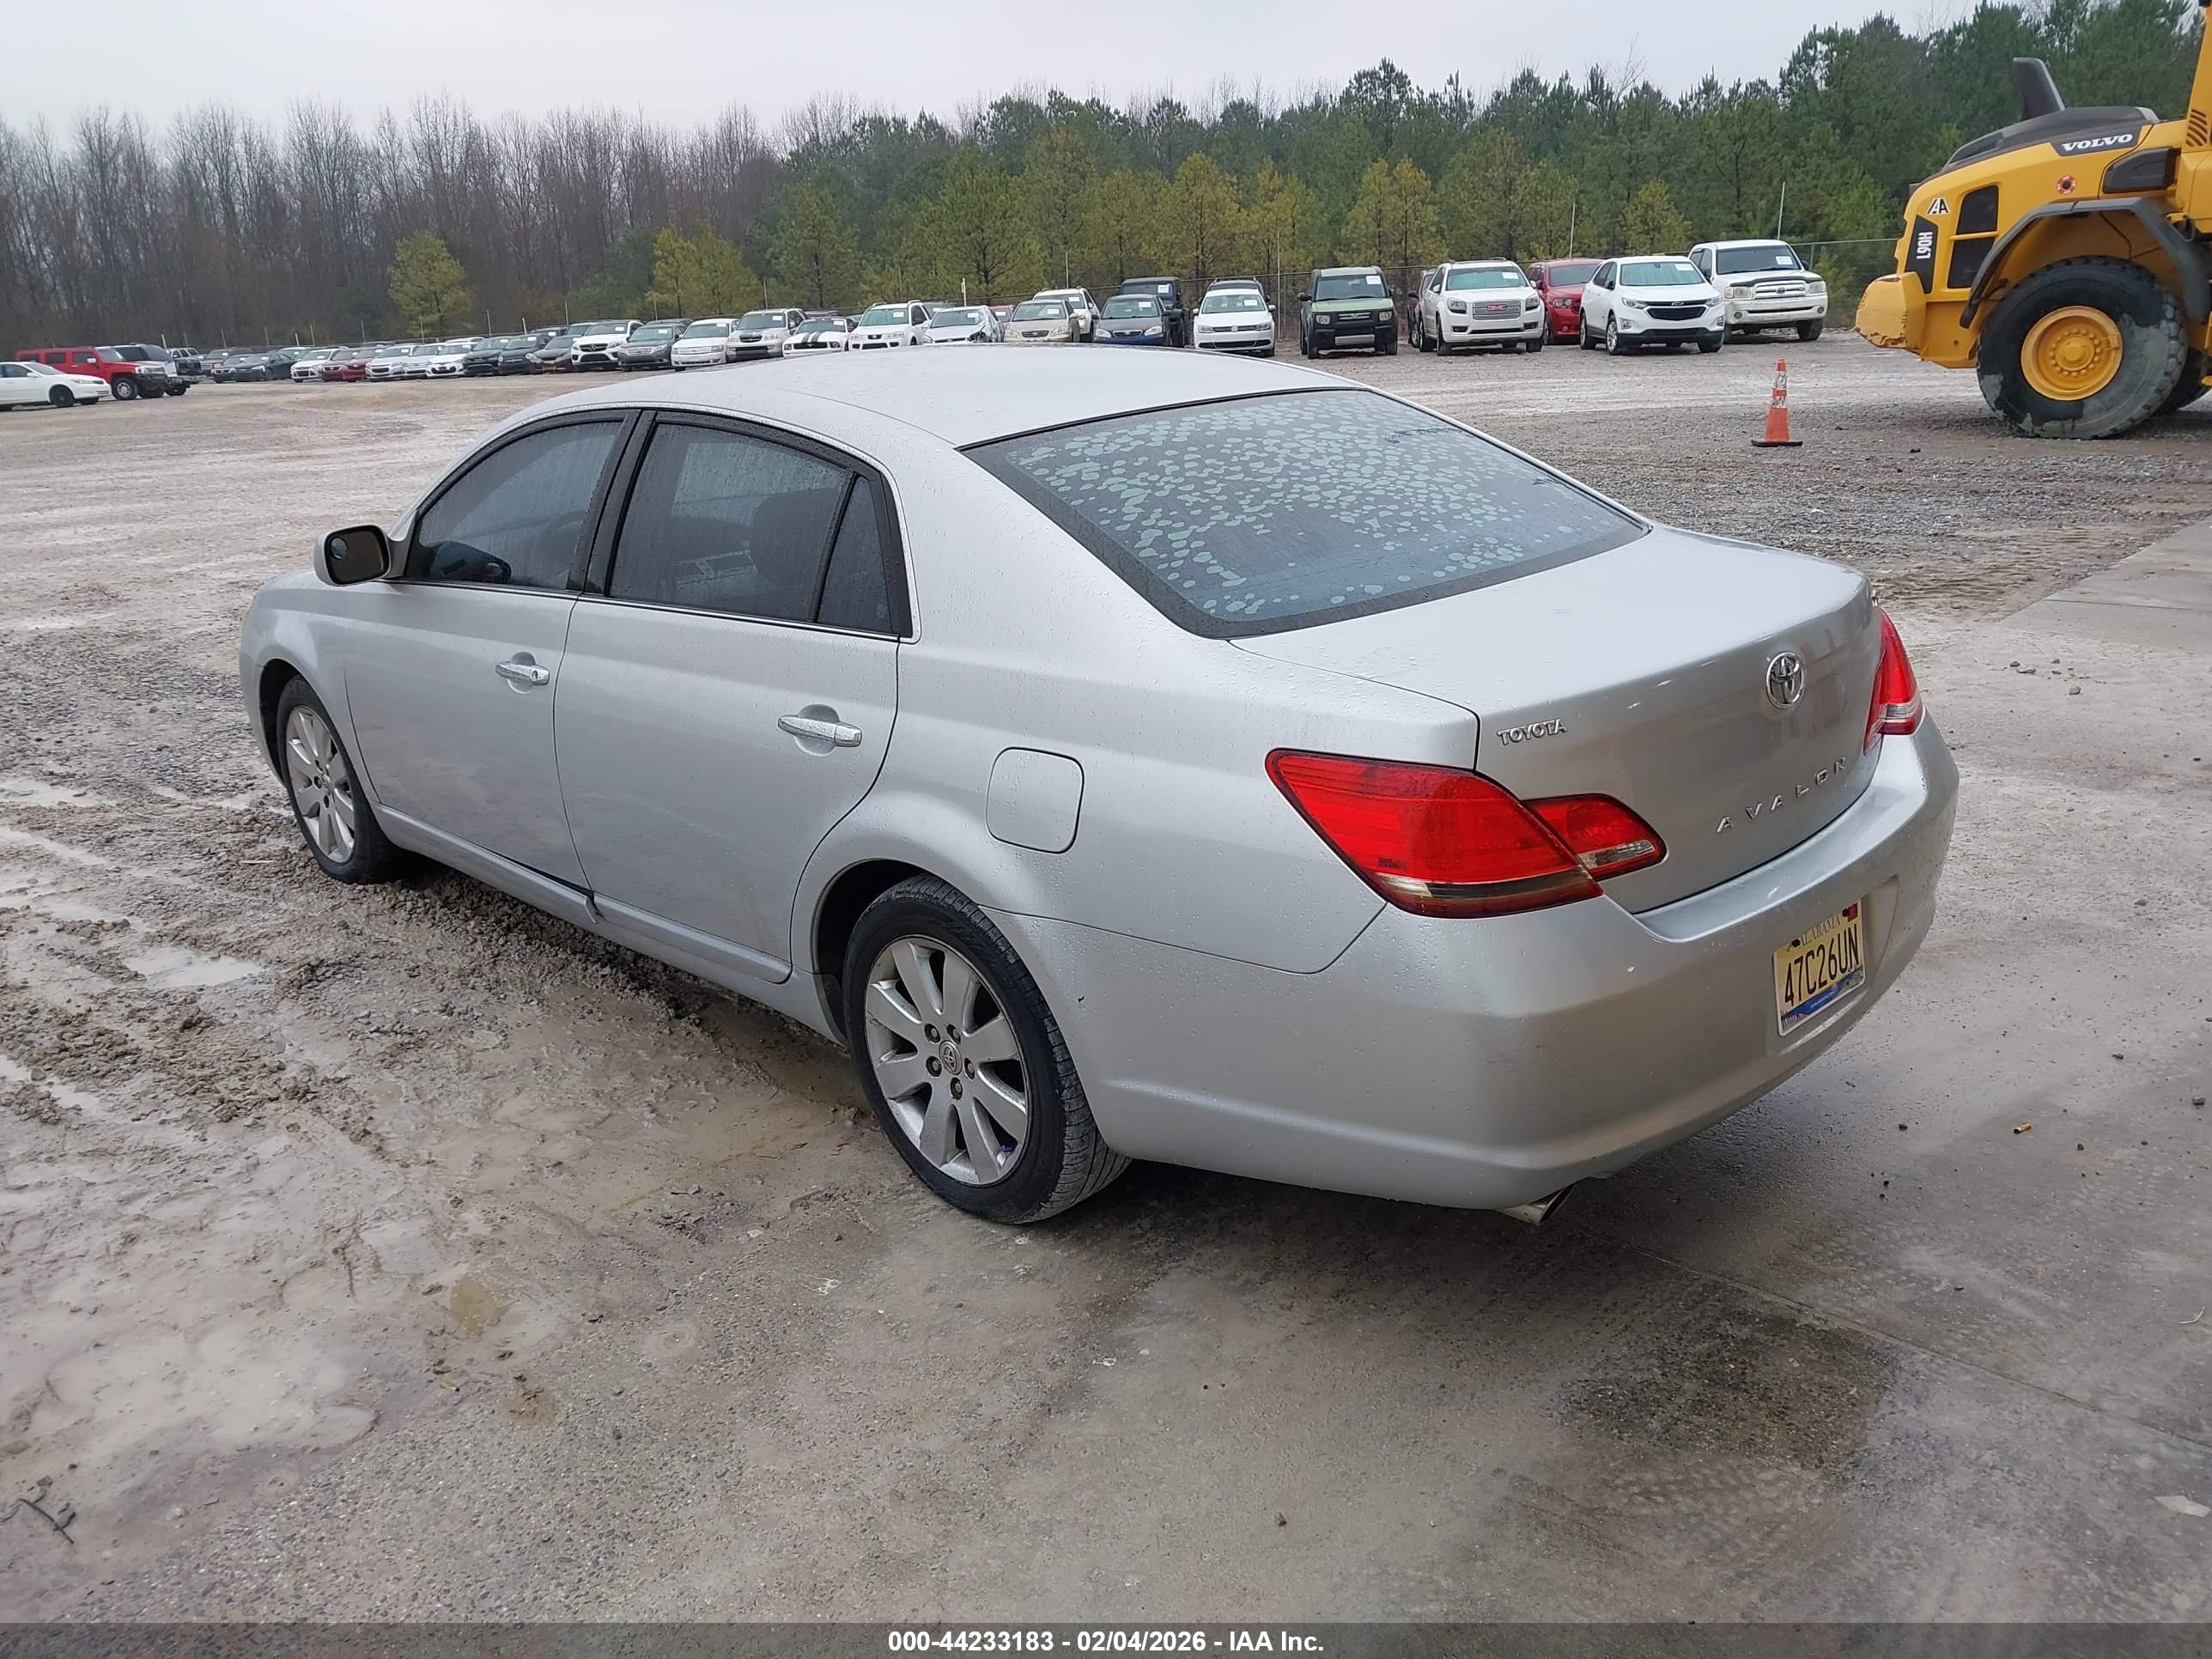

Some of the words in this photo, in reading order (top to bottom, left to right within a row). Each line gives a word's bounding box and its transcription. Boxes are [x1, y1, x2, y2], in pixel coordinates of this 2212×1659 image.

[2062, 133, 2134, 151] VOLVO
[1916, 231, 1934, 259] L90H
[1497, 718, 1567, 745] TOYOTA
[1717, 757, 1847, 833] AVALON
[1799, 915, 1841, 947] ALABAMA
[1784, 923, 1859, 1007] 47C26UN
